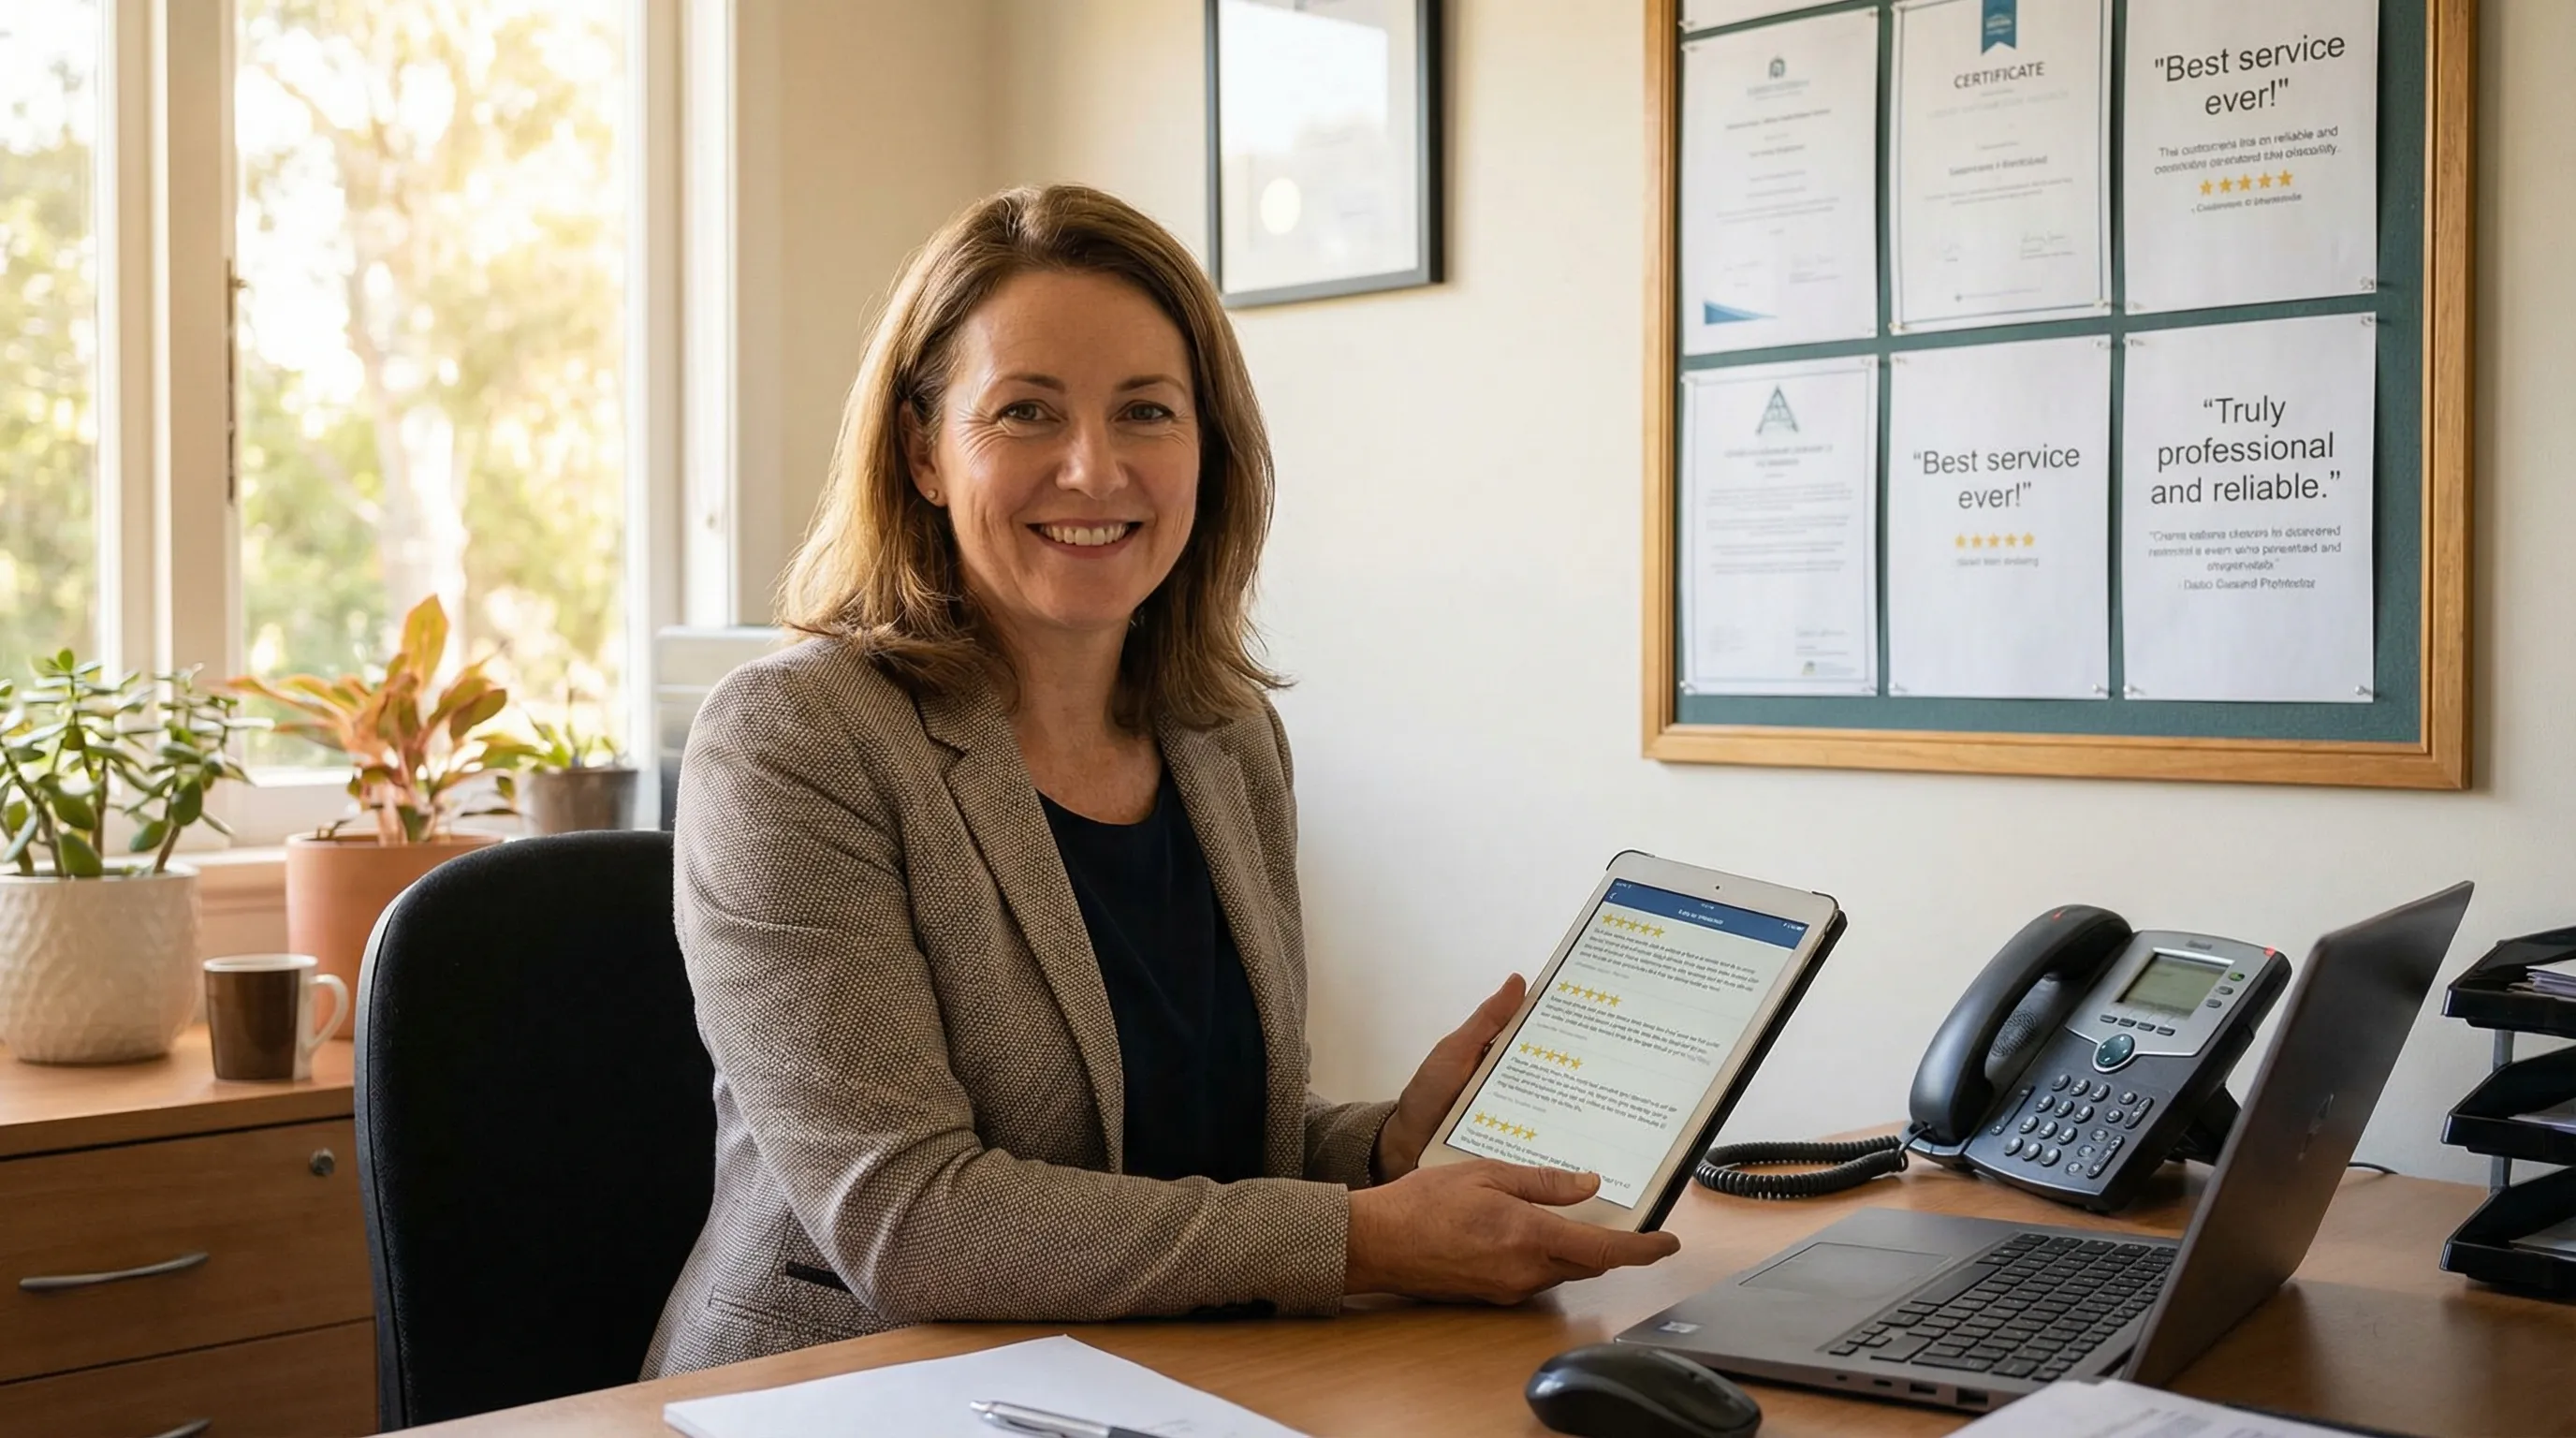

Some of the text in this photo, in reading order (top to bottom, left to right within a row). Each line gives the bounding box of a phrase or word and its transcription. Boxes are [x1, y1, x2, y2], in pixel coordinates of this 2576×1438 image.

[1954, 61, 2045, 89] CERTIFICATE
[2155, 34, 2346, 82] "Best service
[2204, 77, 2289, 116] ever!"
[1986, 443, 2080, 472] service
[2158, 431, 2334, 474] professional
[2150, 477, 2202, 505] and
